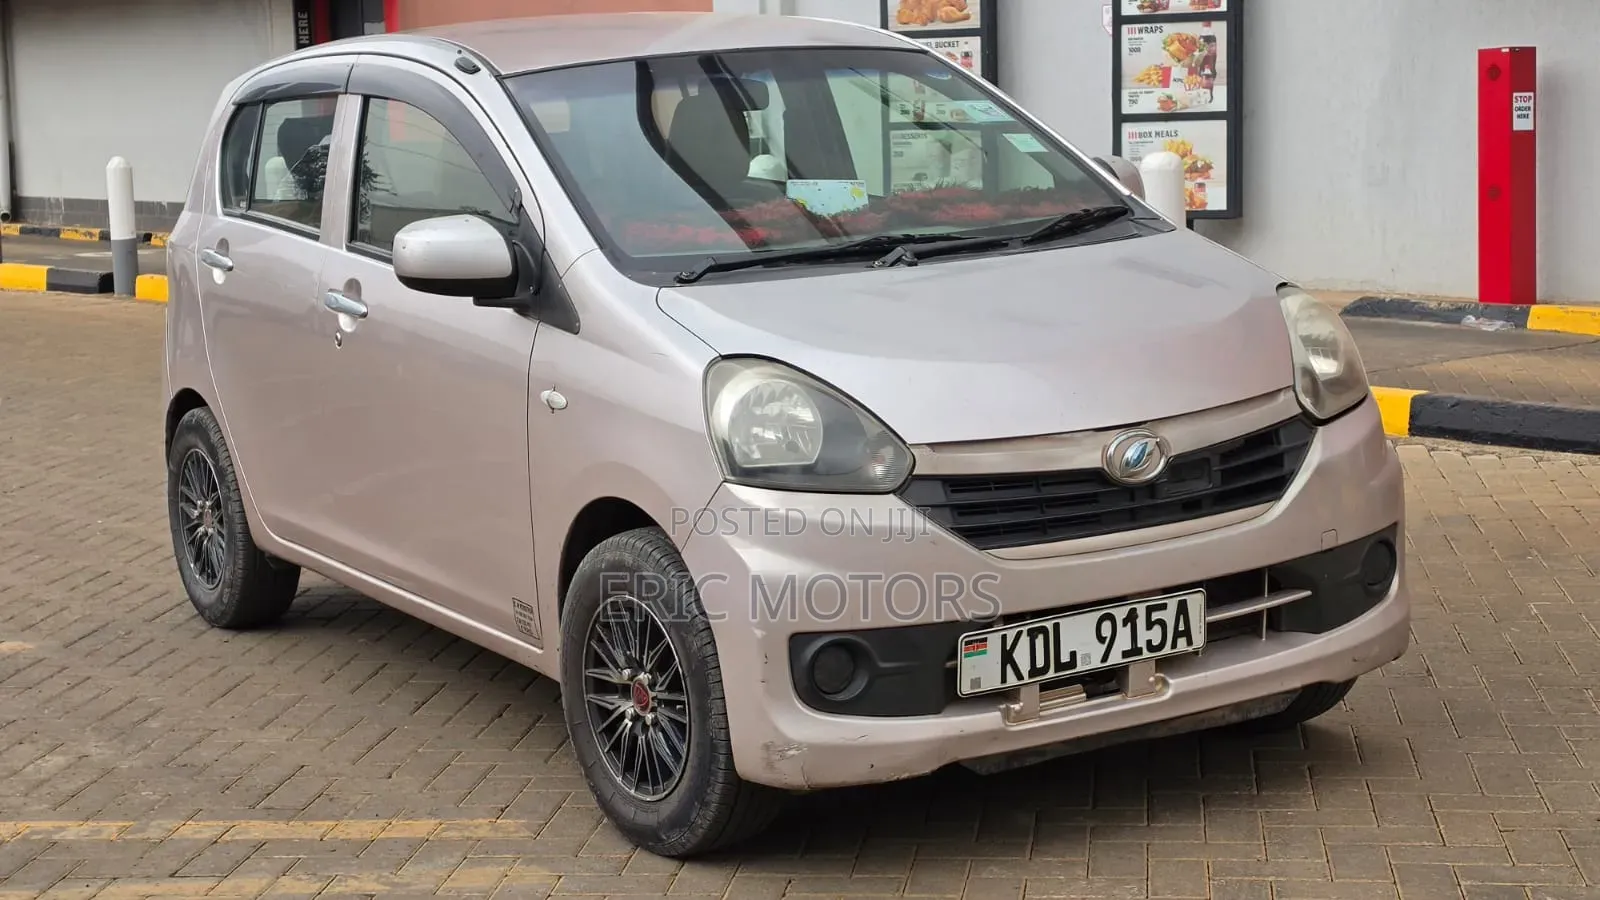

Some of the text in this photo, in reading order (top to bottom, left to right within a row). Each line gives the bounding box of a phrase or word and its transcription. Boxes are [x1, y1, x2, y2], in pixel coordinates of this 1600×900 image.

[298, 11, 309, 44] HERE
[1137, 25, 1163, 34] WRAPS
[934, 40, 960, 48] BUCKET
[1514, 95, 1532, 103] STOP
[1138, 130, 1178, 139] BOX MEALS
[1000, 621, 1078, 685] KDL
[1095, 598, 1194, 664] 915A
